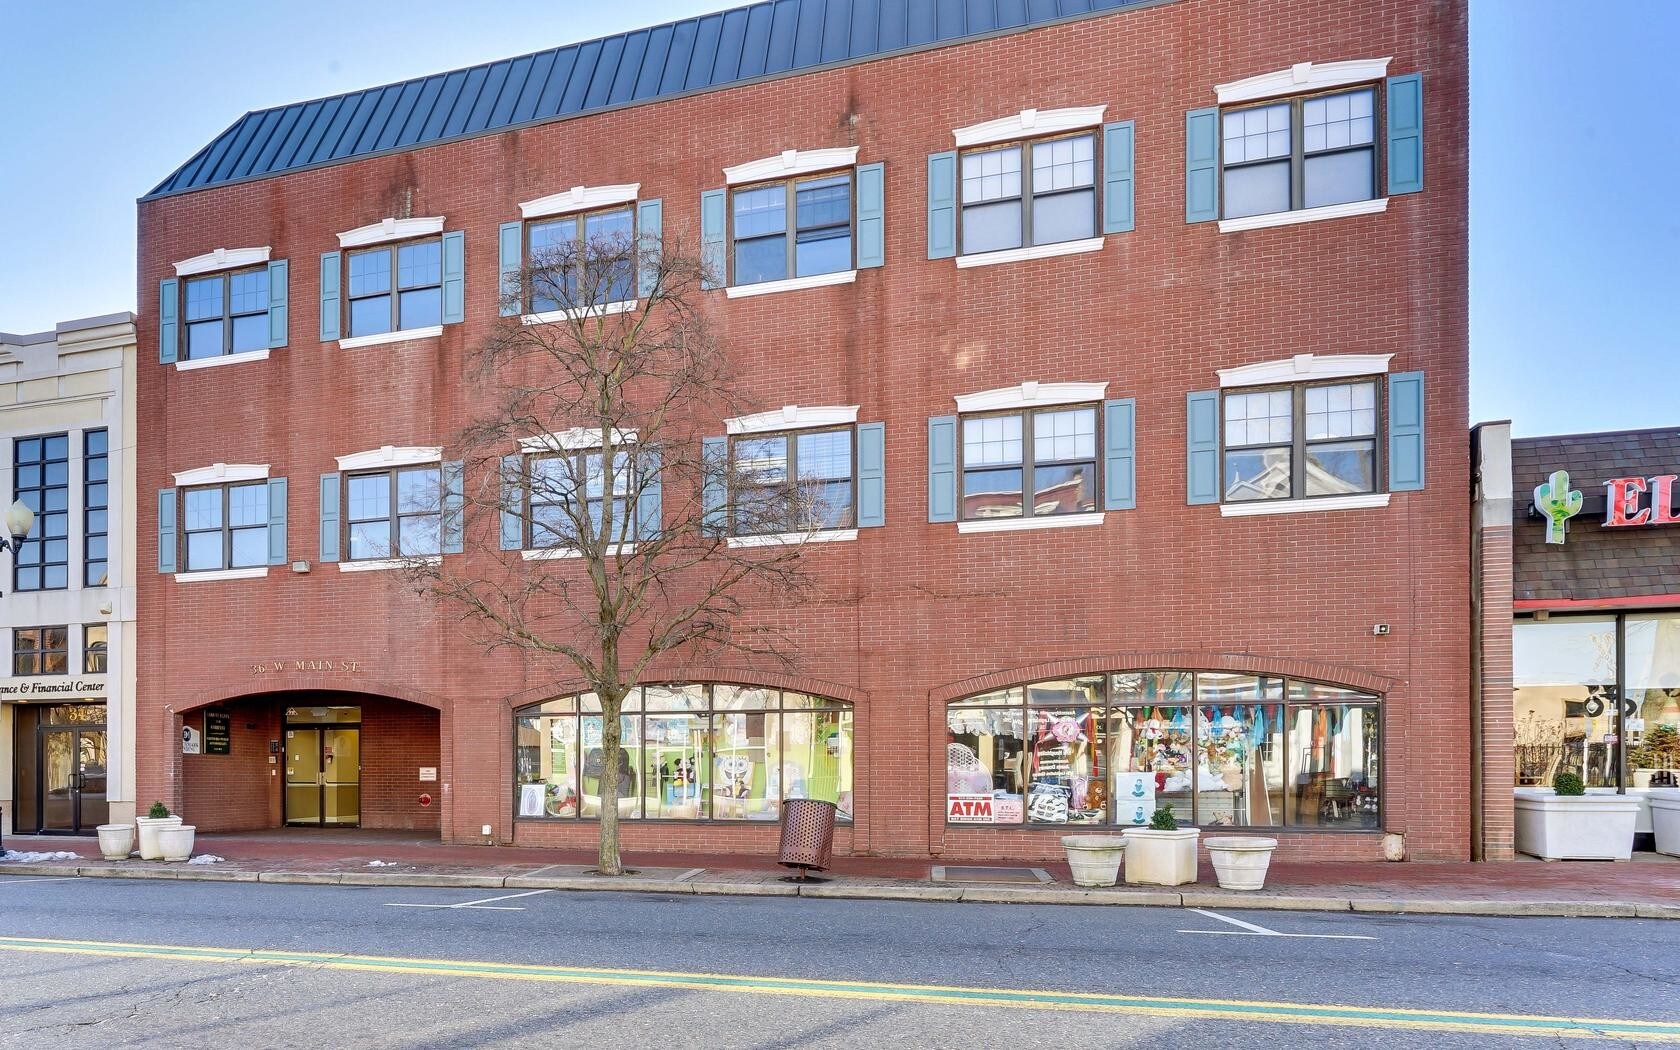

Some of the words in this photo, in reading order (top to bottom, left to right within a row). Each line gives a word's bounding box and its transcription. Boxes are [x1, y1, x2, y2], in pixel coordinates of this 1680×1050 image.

[1601, 475, 1680, 527] EL
[251, 664, 265, 674] 36
[273, 661, 286, 671] W
[295, 660, 335, 671] MAIN
[0, 686, 18, 694] ance
[20, 683, 30, 693] &
[31, 682, 73, 693] Financial
[75, 681, 104, 691] Center
[69, 708, 86, 721] 34
[950, 802, 992, 816] ATM
